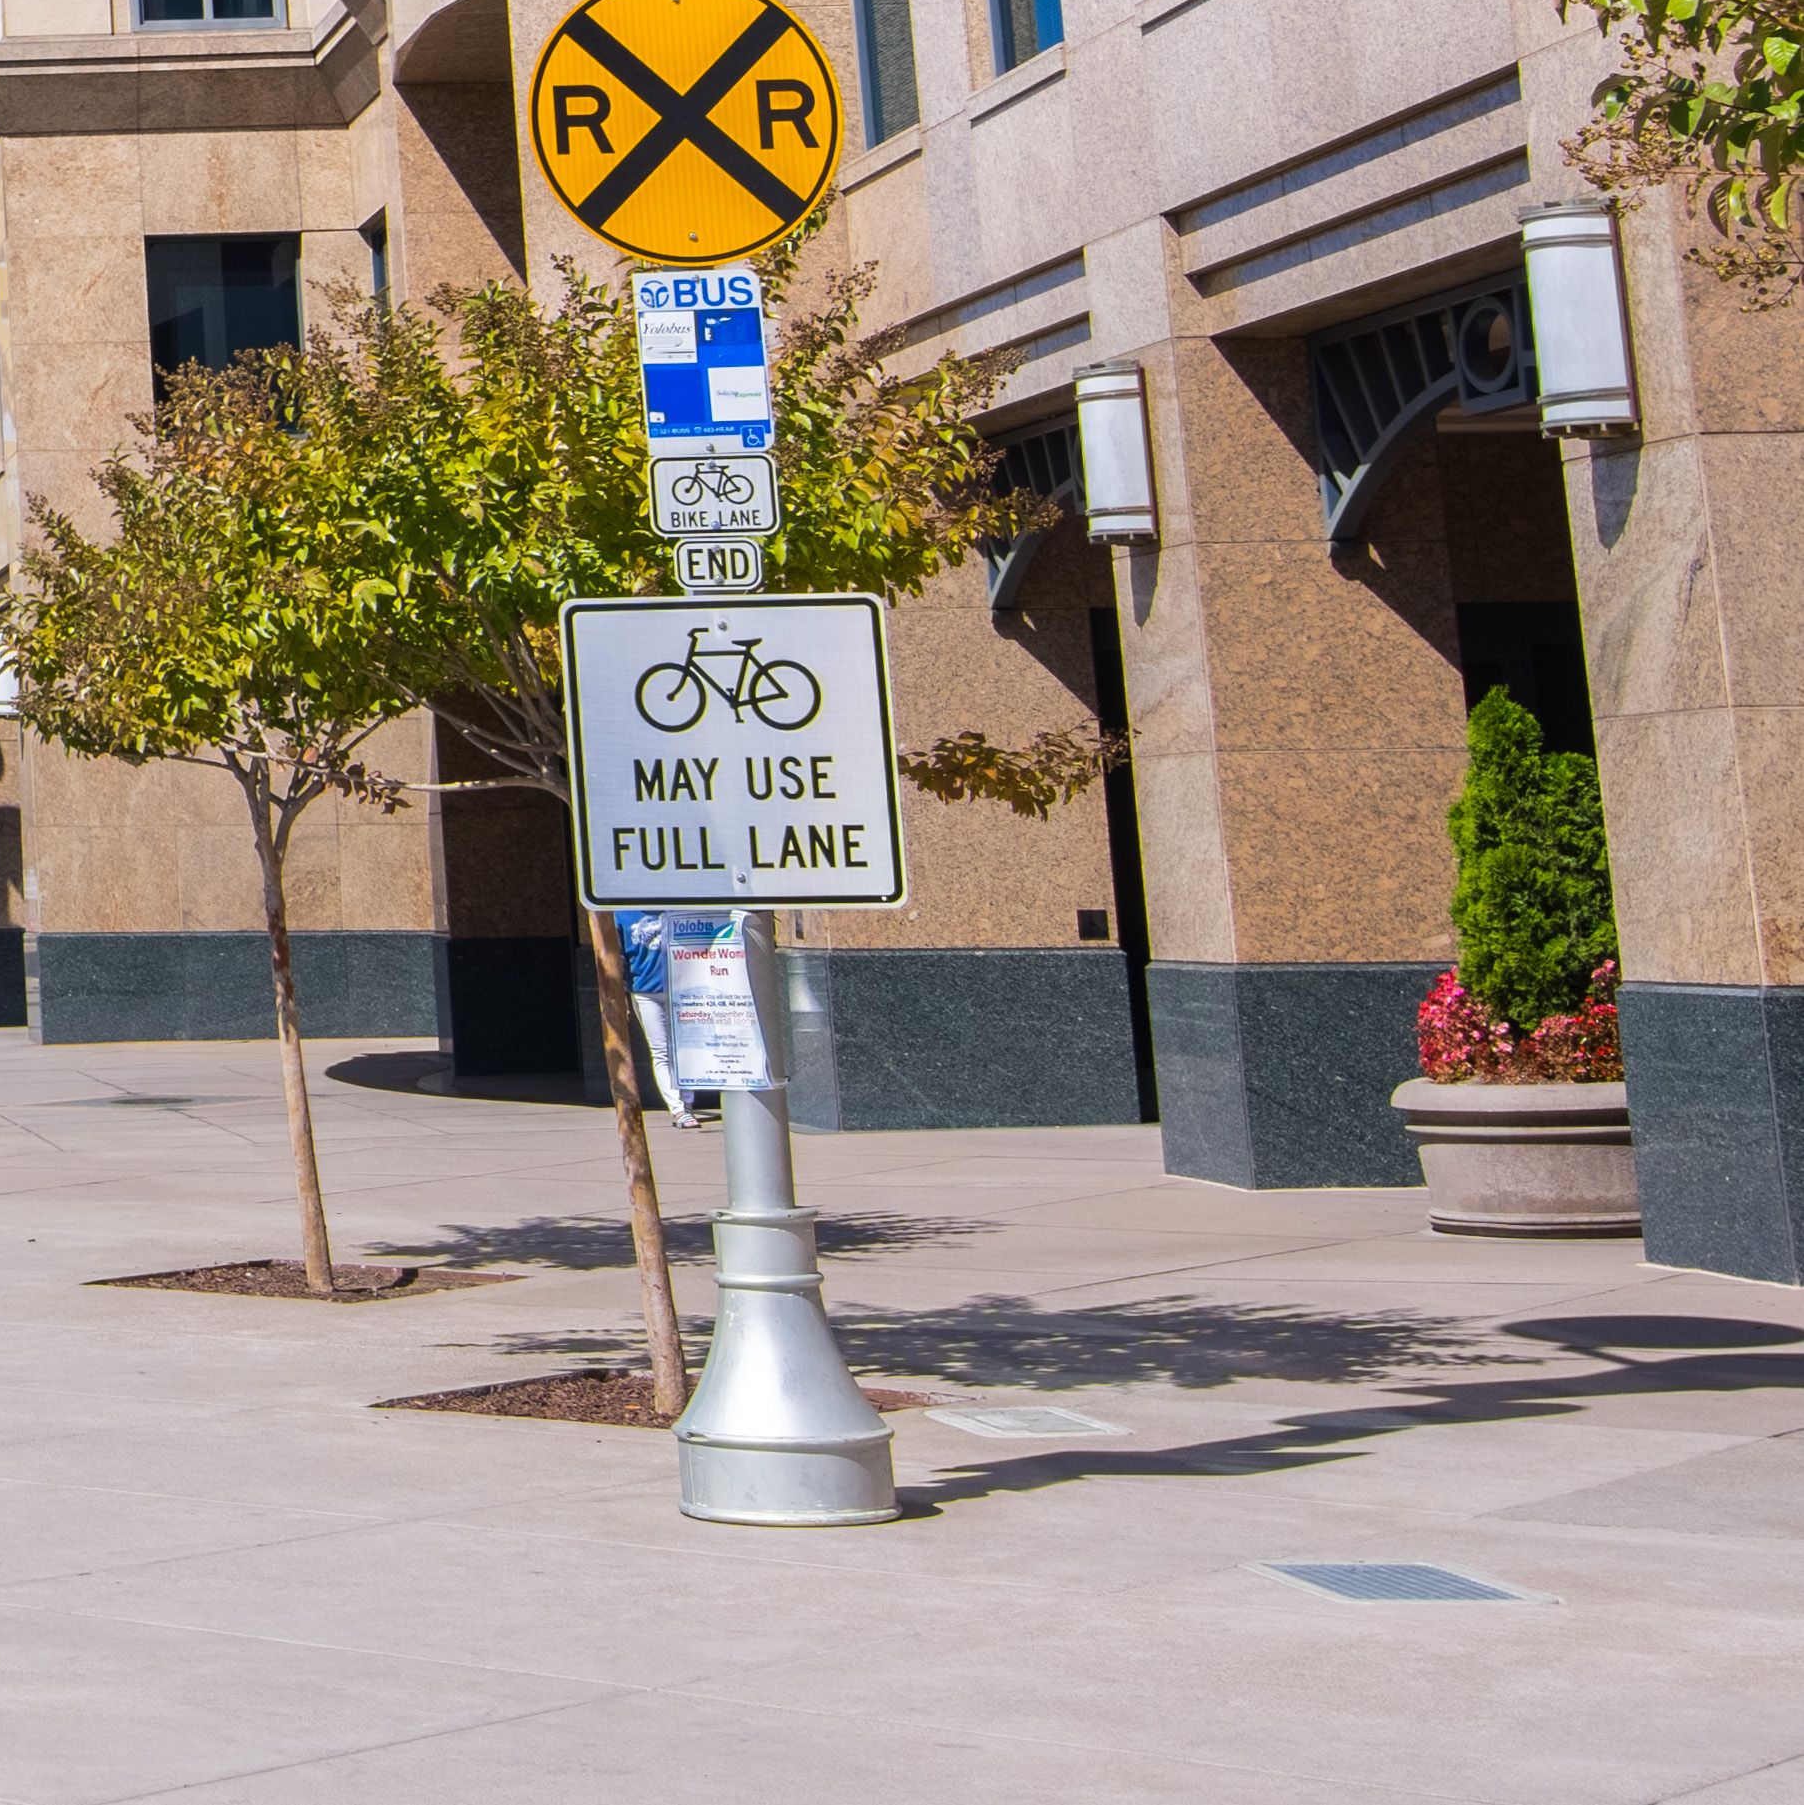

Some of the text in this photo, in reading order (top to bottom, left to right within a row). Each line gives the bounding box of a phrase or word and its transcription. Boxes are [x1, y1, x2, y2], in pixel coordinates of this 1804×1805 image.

[673, 276, 753, 308] BUS
[643, 322, 692, 335] Yolobus
[671, 509, 761, 528] BIKE LANE
[687, 548, 749, 580] END
[633, 755, 837, 802] MAY USE
[612, 825, 868, 870] FULL LANE
[673, 919, 715, 933] Yolobus
[672, 948, 717, 961] Wonder
[710, 965, 729, 976] Run
